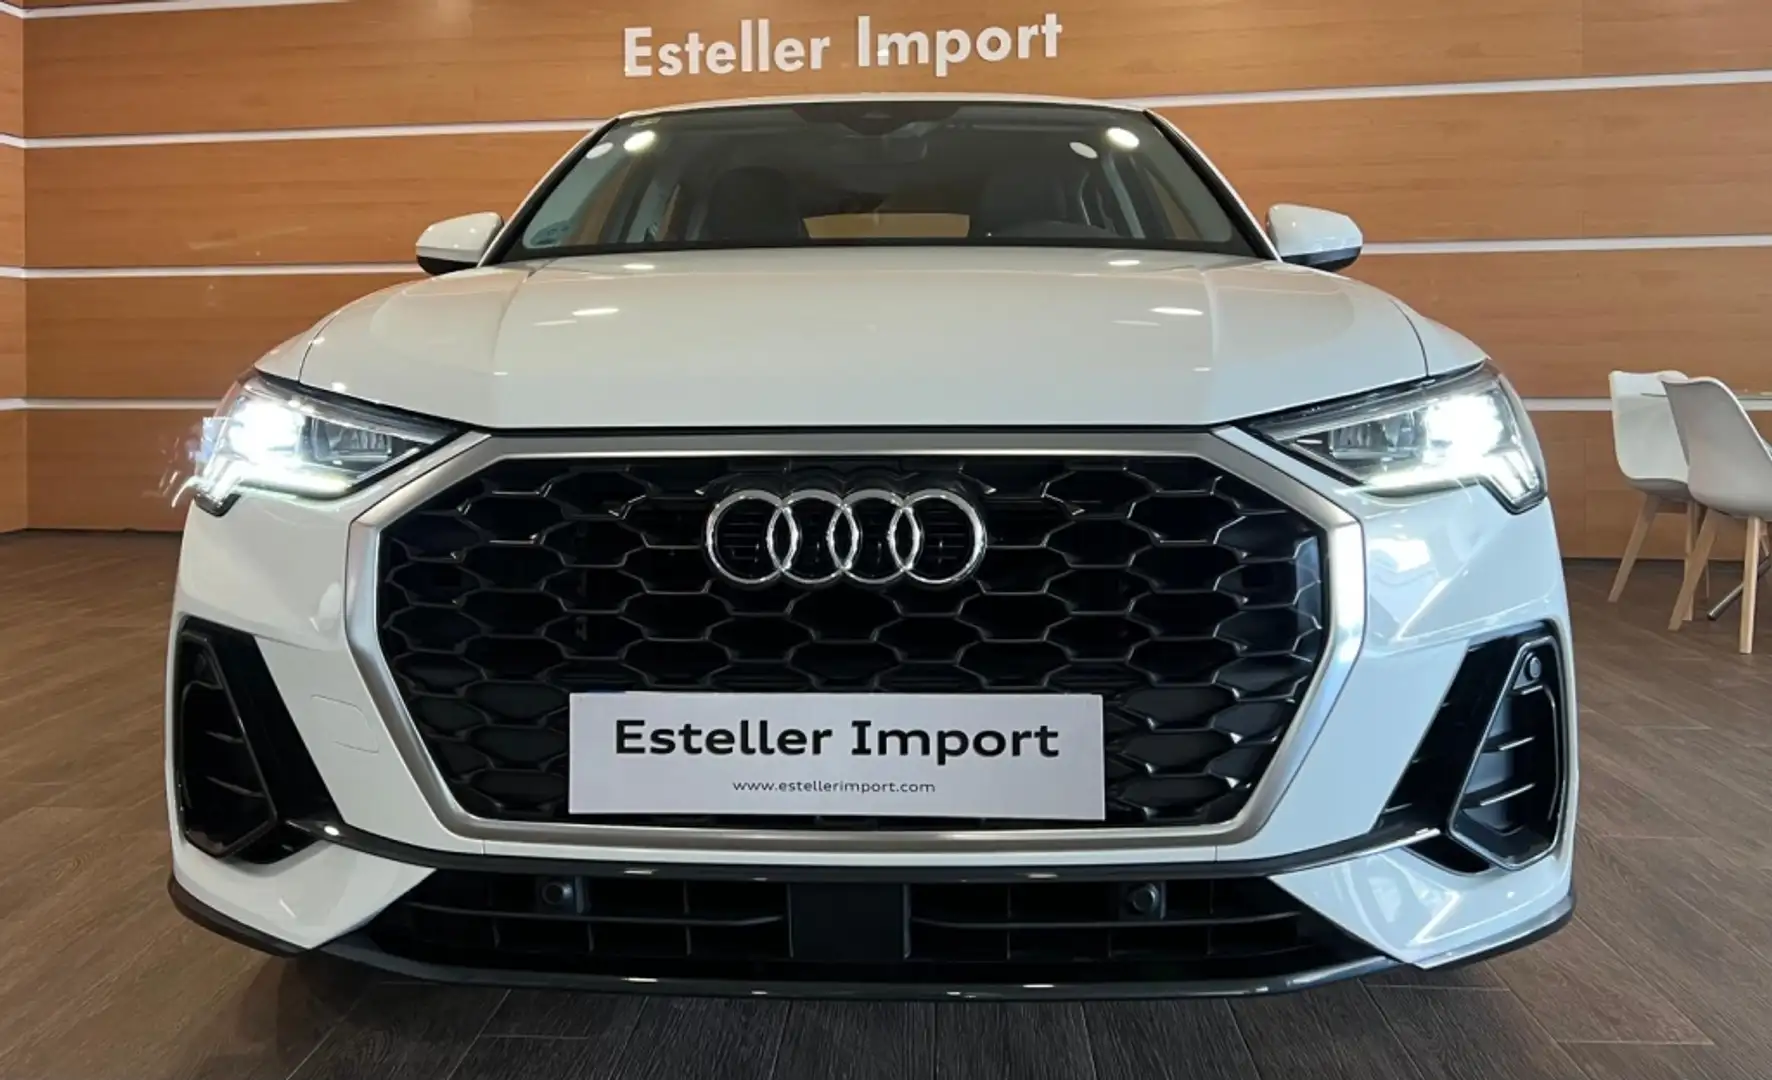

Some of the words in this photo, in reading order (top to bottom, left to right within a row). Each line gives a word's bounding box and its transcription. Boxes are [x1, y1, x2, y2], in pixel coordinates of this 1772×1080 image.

[624, 19, 831, 77] Esteller
[858, 13, 1063, 77] Import
[615, 719, 833, 756] Esteller
[851, 720, 1060, 767] Import
[732, 780, 936, 794] www.estellerimport.com
